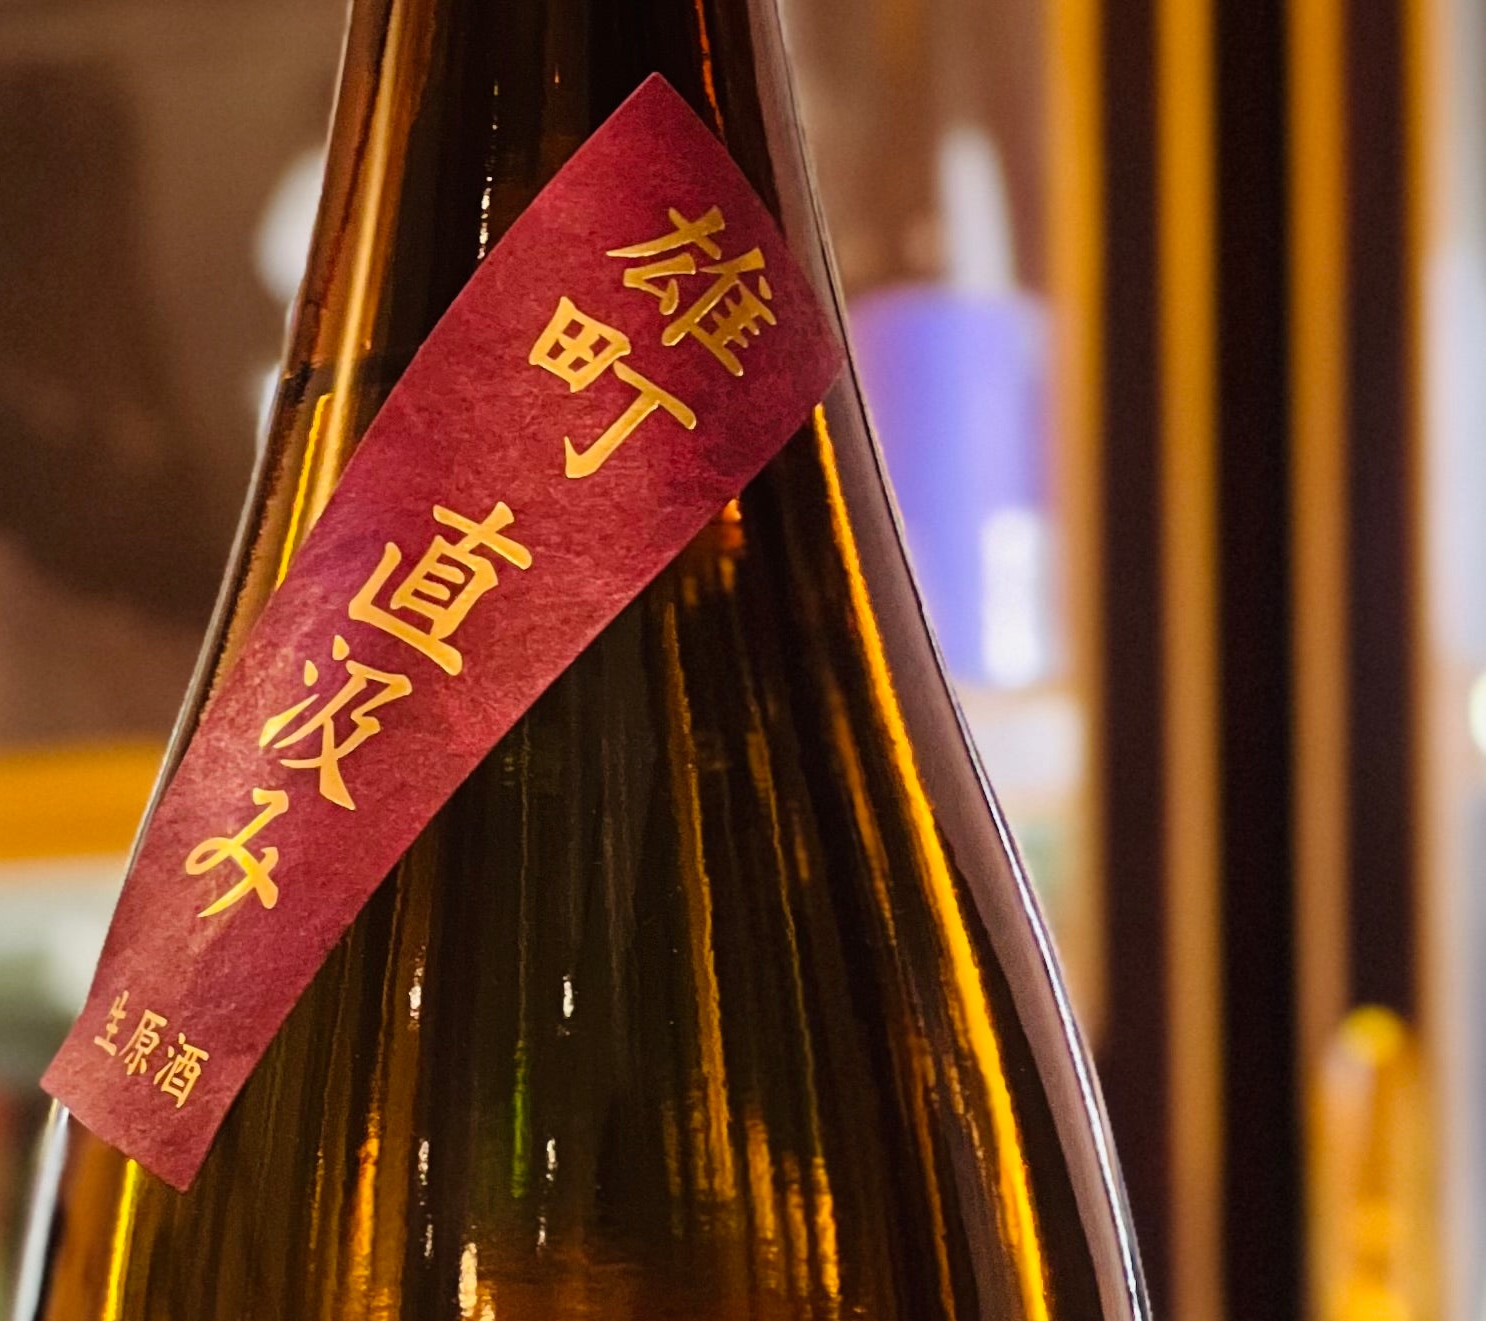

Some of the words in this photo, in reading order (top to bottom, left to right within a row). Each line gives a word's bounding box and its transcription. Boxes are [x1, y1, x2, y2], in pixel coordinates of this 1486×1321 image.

[529, 205, 778, 479] 雄町
[185, 501, 532, 919] 直汲み
[94, 992, 212, 1108] 生原酒
